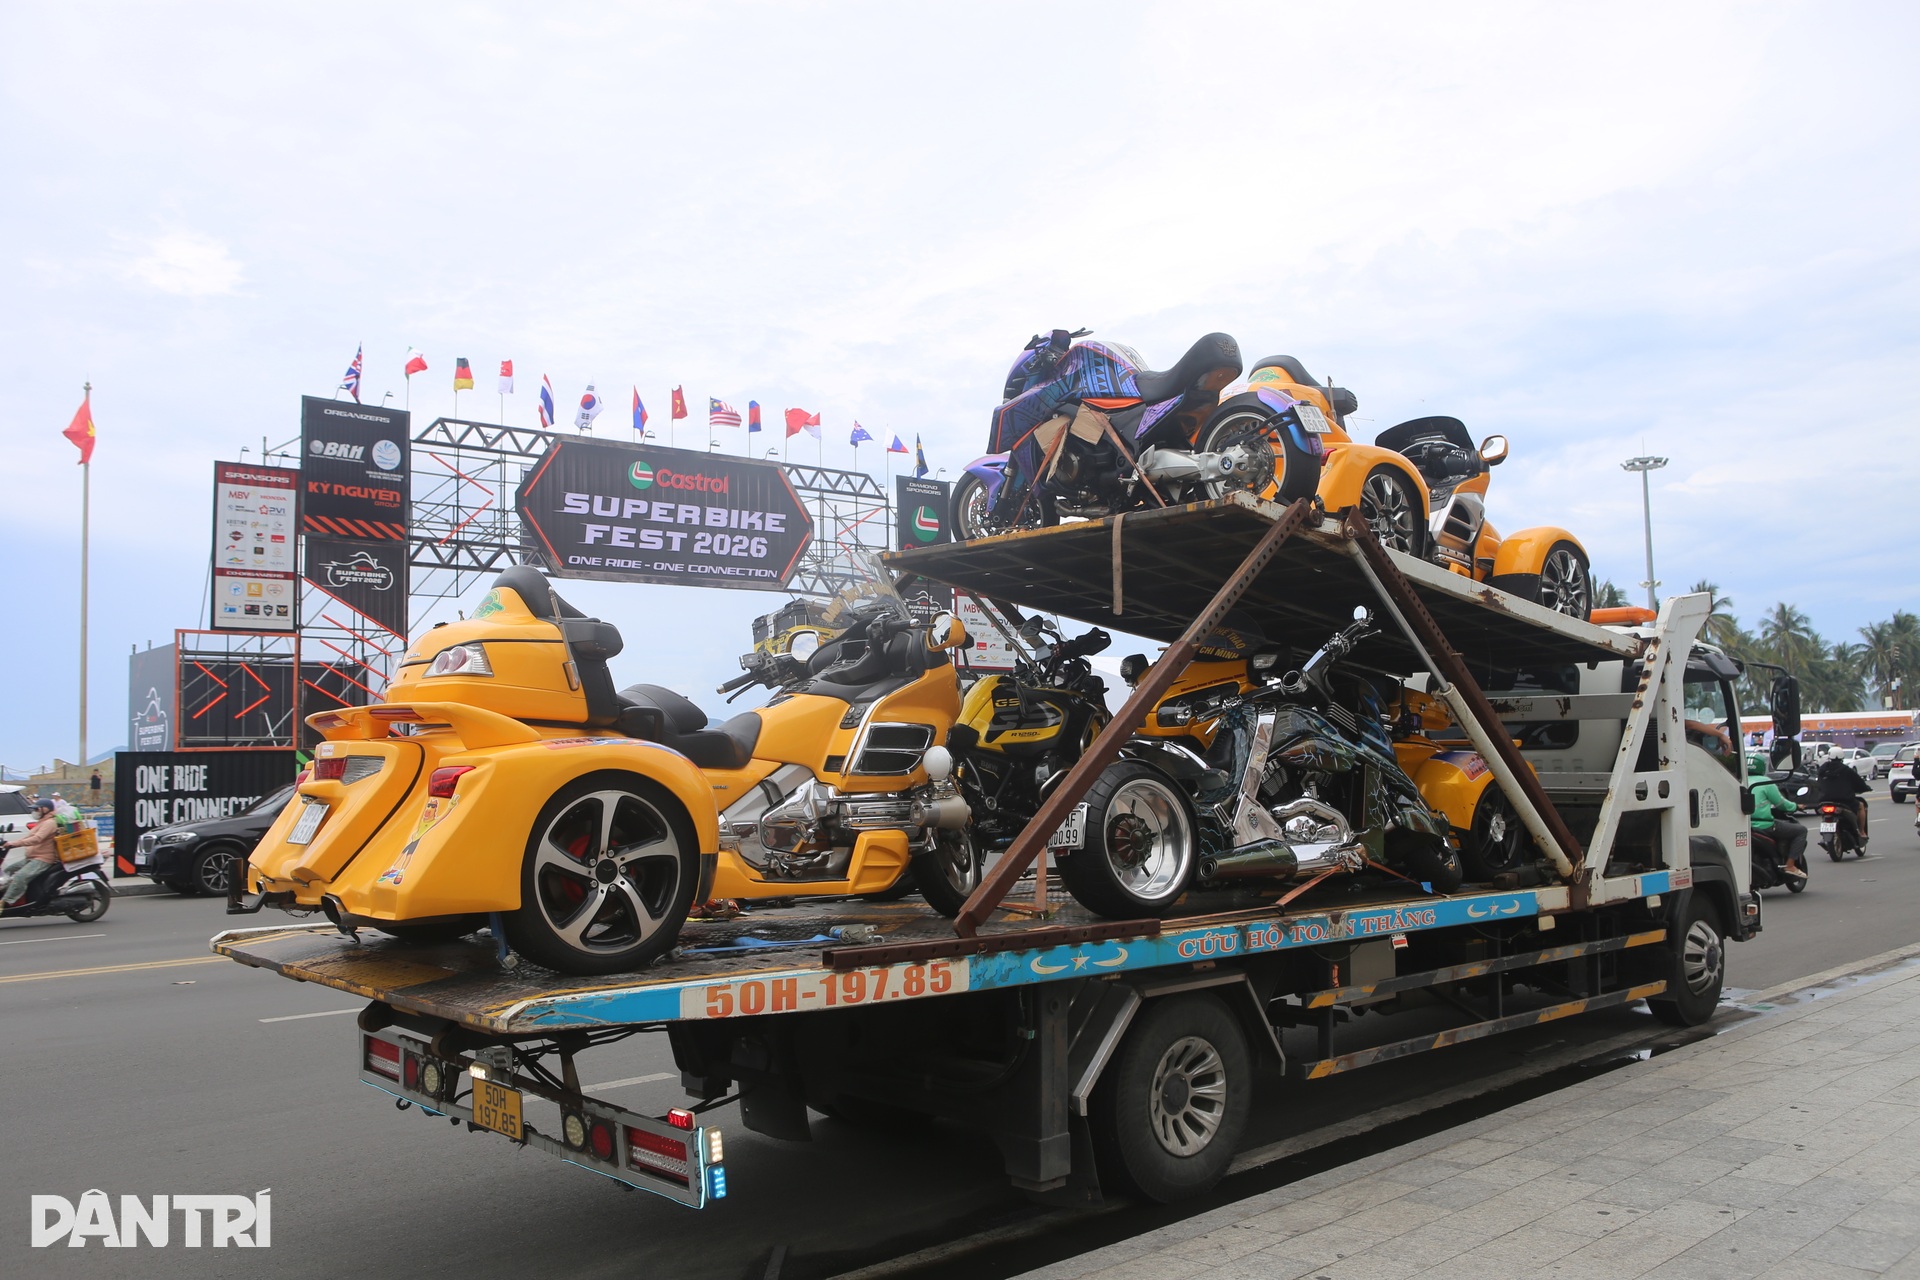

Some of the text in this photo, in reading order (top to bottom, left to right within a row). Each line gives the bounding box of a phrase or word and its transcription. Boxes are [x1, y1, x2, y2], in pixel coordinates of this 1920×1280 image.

[324, 408, 391, 424] ORGANIZERS
[225, 471, 290, 484] SPONSORS
[656, 468, 729, 494] Castrol
[909, 482, 938, 490] DIAMOND
[228, 490, 250, 500] MBV
[906, 487, 942, 496] SPONSORS
[269, 506, 286, 514] PVI
[374, 500, 400, 508] GROUP
[556, 491, 787, 533] SUPERBIKE
[577, 523, 768, 559] FEST 2026
[335, 570, 387, 578] SUPERBIKE
[568, 555, 602, 567] ONE
[604, 558, 642, 570] RIDE
[653, 561, 684, 572] ONE
[687, 564, 778, 579] CONNECTION
[995, 698, 1020, 708] GS
[135, 764, 208, 793] ONE RIDE
[134, 799, 169, 828] ONE
[1178, 931, 1238, 958] CỨU
[1245, 924, 1284, 949] HỘ
[706, 962, 952, 1019] 50H-197.85
[485, 1085, 506, 1109] 50H
[479, 1104, 516, 1135] 197.85
